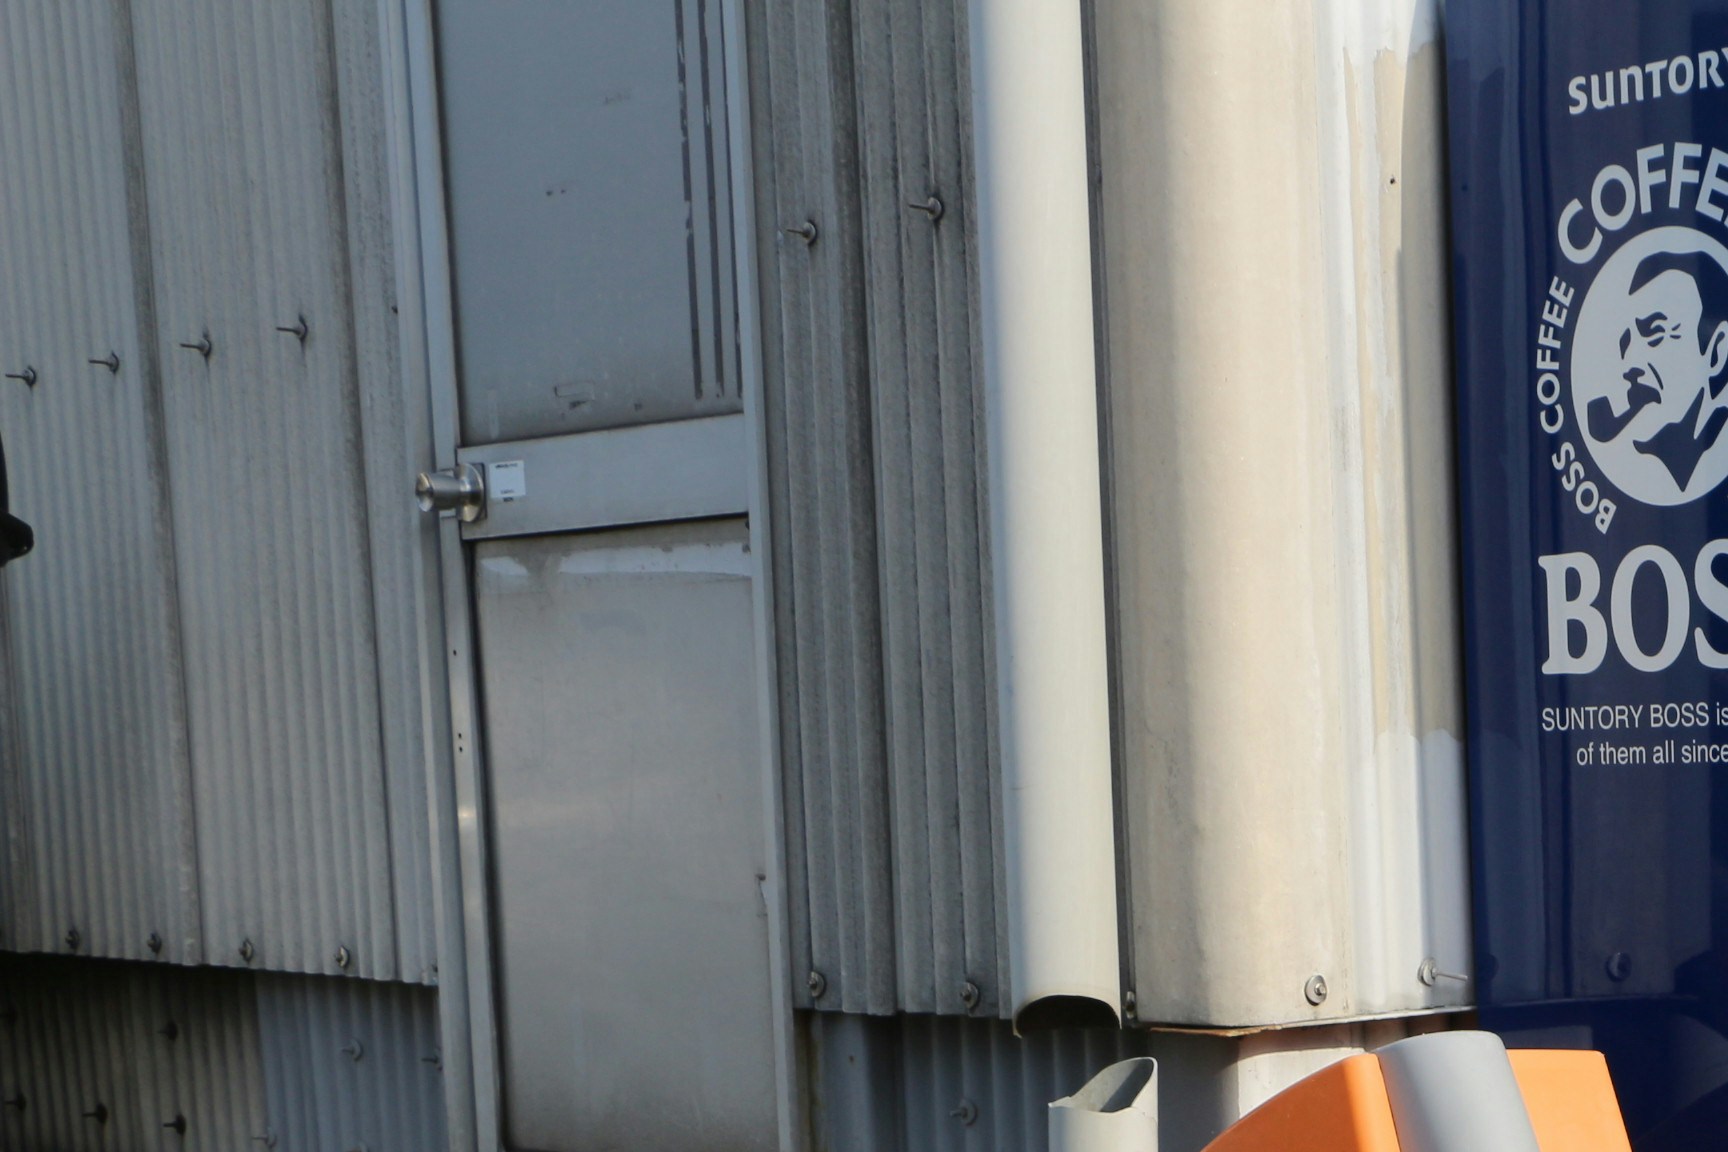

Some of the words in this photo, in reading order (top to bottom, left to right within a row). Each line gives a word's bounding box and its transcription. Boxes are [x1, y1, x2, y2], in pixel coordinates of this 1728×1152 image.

[1541, 705, 1644, 732] SUNTORY
[1650, 703, 1710, 729] BOSS
[1576, 742, 1595, 766] of
[1599, 741, 1647, 764] them
[1652, 740, 1675, 763] all
